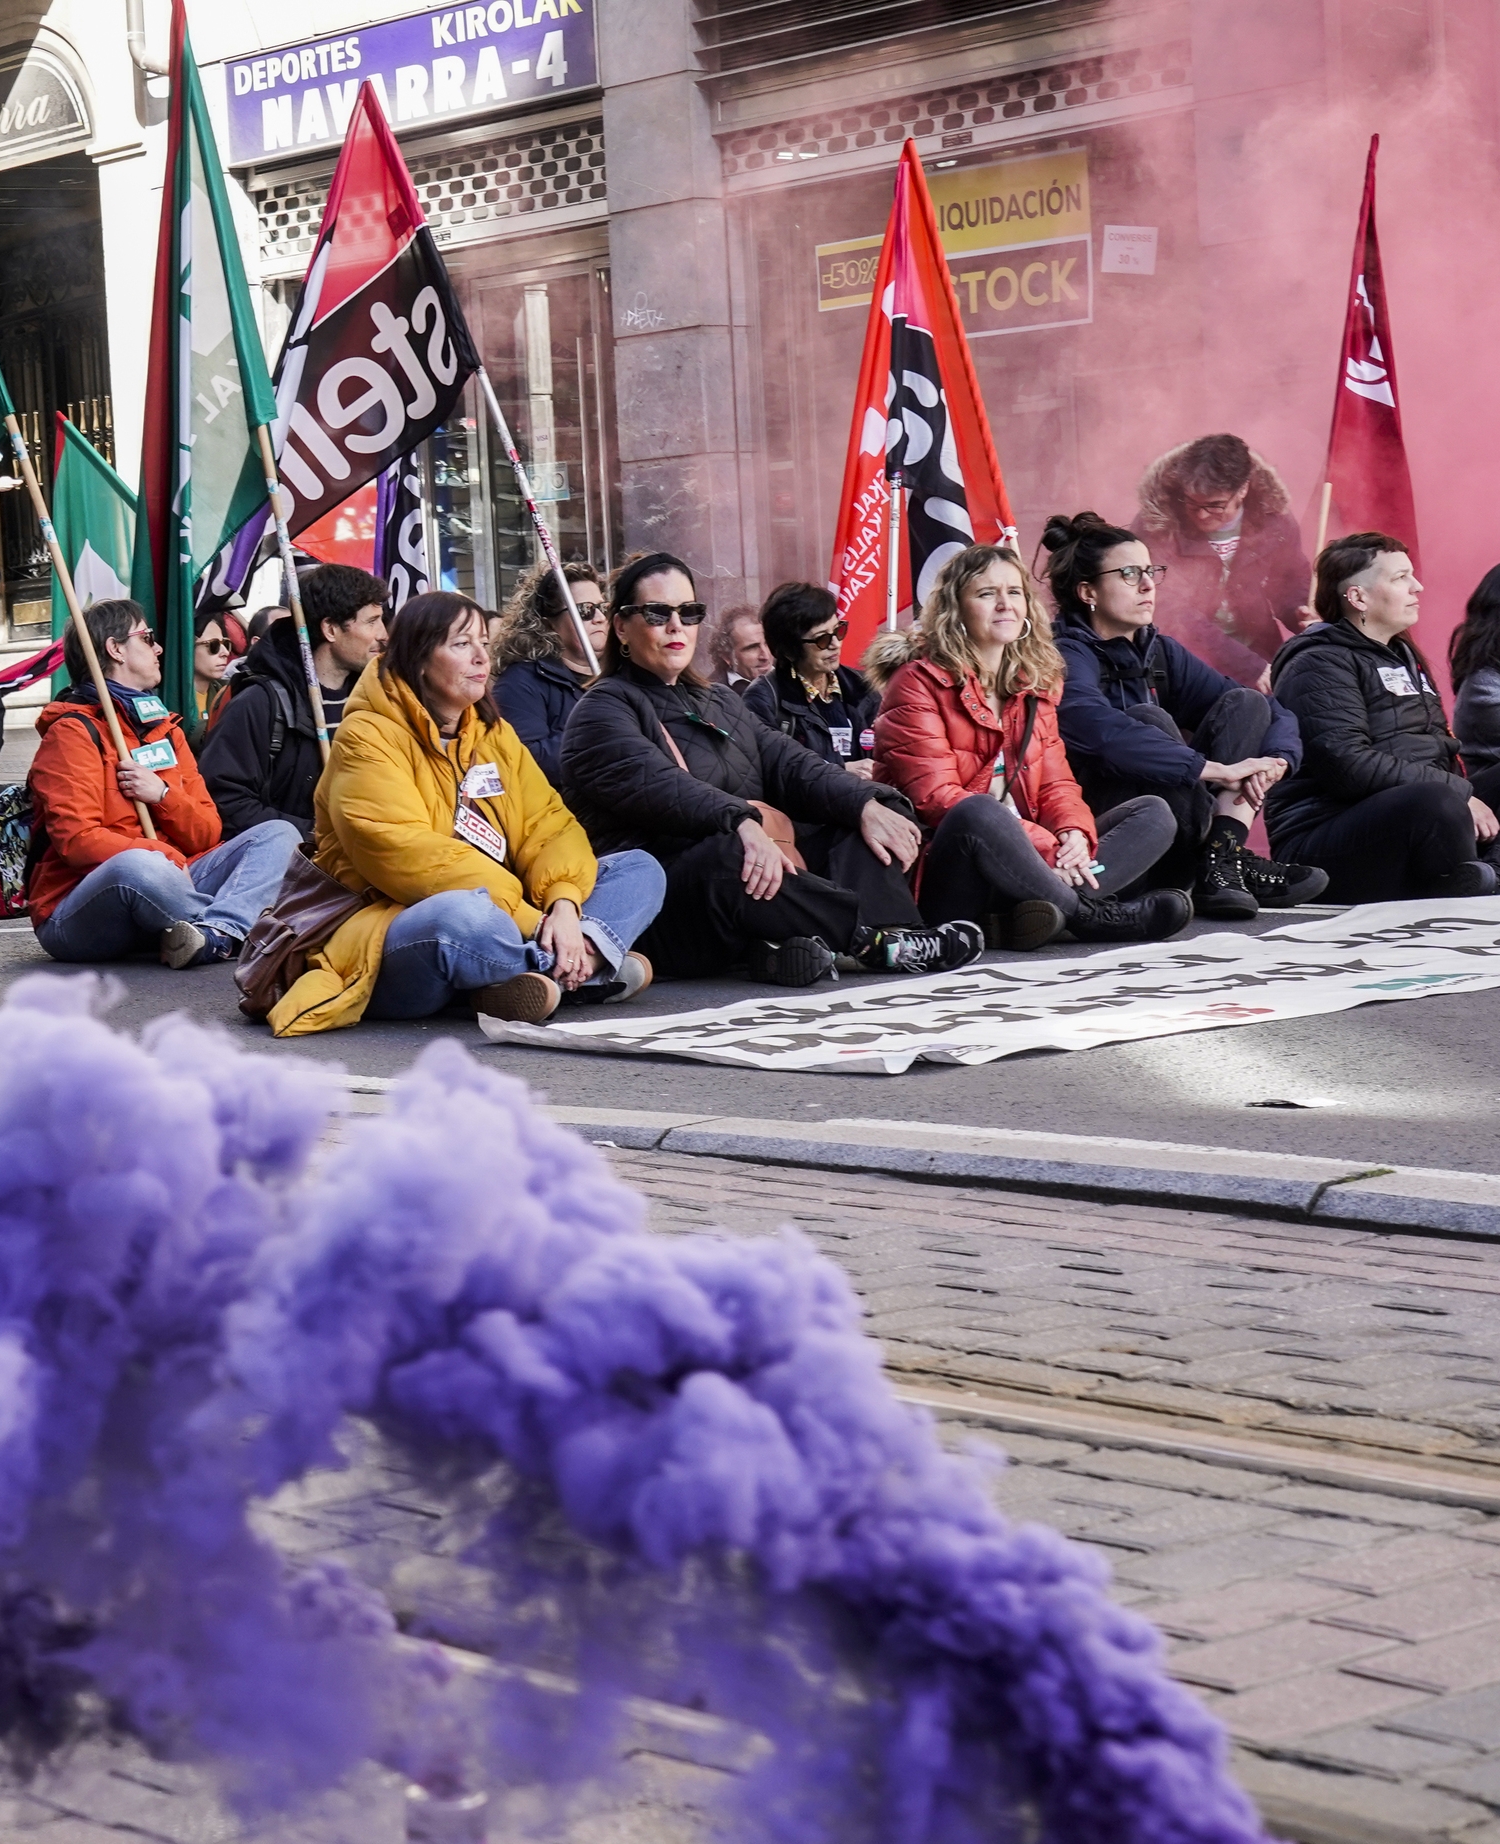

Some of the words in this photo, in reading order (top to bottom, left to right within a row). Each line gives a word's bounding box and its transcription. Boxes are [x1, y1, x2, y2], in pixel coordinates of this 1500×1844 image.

[233, 37, 362, 96] DEPORTES
[261, 29, 569, 152] NAVARRA-4
[937, 179, 1082, 232] IQUIDACIÓN
[1108, 231, 1153, 244] CONVERSE
[1118, 253, 1132, 266] 30
[137, 700, 165, 715] ELA
[137, 747, 169, 766] ELA
[456, 822, 500, 859] akaskuntza
